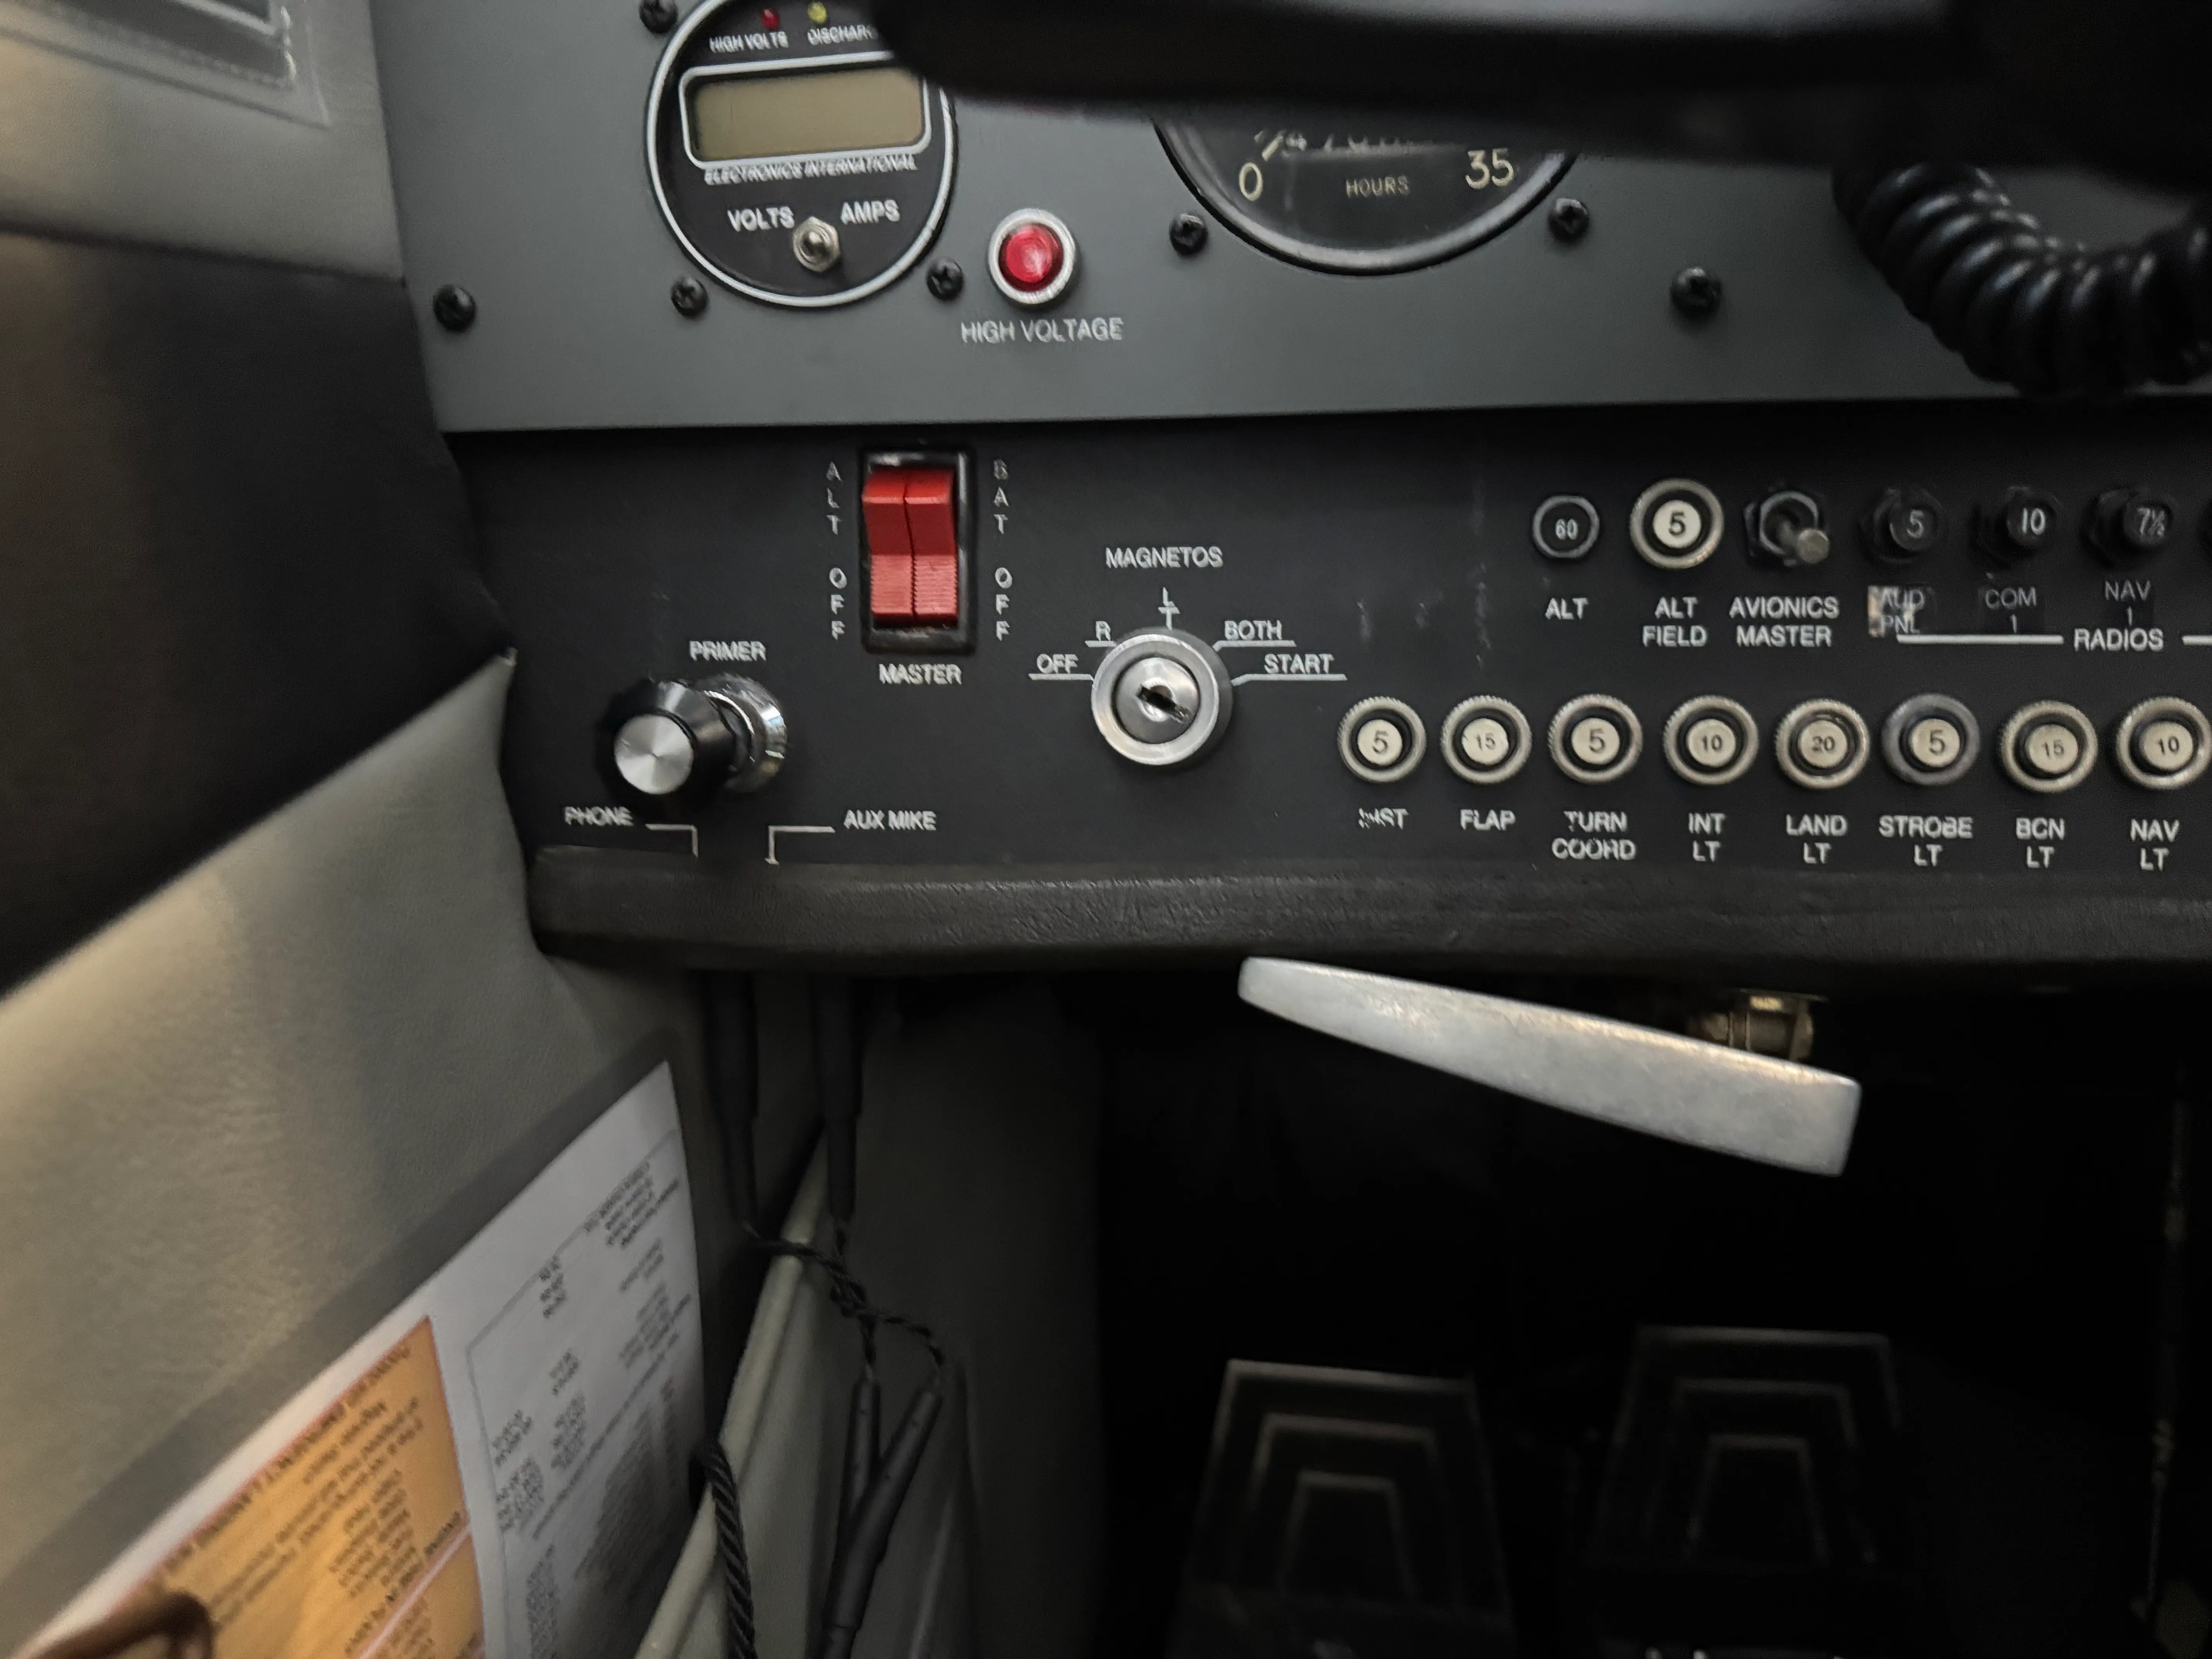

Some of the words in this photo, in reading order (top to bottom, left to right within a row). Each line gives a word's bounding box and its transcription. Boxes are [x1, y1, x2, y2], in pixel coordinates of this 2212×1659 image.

[709, 35, 742, 53] HIGH
[745, 31, 789, 51] VOLTS
[704, 162, 802, 186] ELECTRONICS
[804, 155, 918, 178] INTERNATIONAL
[1465, 148, 1514, 189] 35
[1240, 162, 1263, 201] 0
[1346, 176, 1410, 198] HOURS
[727, 206, 795, 232] VOLTS
[841, 199, 900, 225] AMPS
[961, 320, 1016, 344] HIGH
[1022, 317, 1124, 342] VOLTAGE
[1555, 519, 1578, 541] 60
[1668, 512, 1686, 537] 5
[1906, 510, 1924, 538] 5
[2021, 508, 2045, 535] 10
[1106, 546, 1223, 569] MAGNETOS
[1162, 587, 1175, 607] L
[1985, 587, 2037, 610] COM
[2105, 580, 2151, 601] NAV
[1546, 598, 1589, 619] ALT
[1655, 597, 1698, 618] ALT
[1730, 596, 1840, 618] AVIONICS
[1096, 620, 1111, 641] R
[1224, 620, 1282, 641] BOTH
[1643, 625, 1707, 647] FIELD
[1737, 625, 1832, 647] MASTER
[2074, 628, 2164, 651] RADIOS
[690, 641, 766, 661] PRIMER
[879, 663, 962, 685] MASTER
[1037, 654, 1079, 674] OFF
[1264, 654, 1335, 674] START
[1371, 730, 1389, 754] 5
[1476, 733, 1496, 750] 15
[1589, 728, 1606, 753] 5
[1702, 735, 1722, 752] 10
[1812, 736, 1835, 753] 20
[1929, 730, 1946, 755] 5
[2043, 741, 2065, 759] 15
[2158, 737, 2180, 755] 10
[565, 806, 634, 826] PHONE
[844, 810, 884, 830] AUX
[888, 811, 937, 831] MIKE
[1460, 809, 1516, 831] FLAP
[1563, 811, 1628, 832] TURN
[1689, 812, 1726, 834] INT
[1786, 814, 1848, 836] LAND
[1879, 815, 1973, 838] STROBE
[2016, 817, 2065, 840] BCN
[2130, 819, 2180, 842] NAV
[1551, 838, 1636, 860] COORD
[1693, 840, 1721, 862] LT
[1803, 842, 1832, 864] LT
[1914, 844, 1943, 867] LT
[2027, 846, 2055, 869] LT
[2140, 848, 2169, 871] LT
